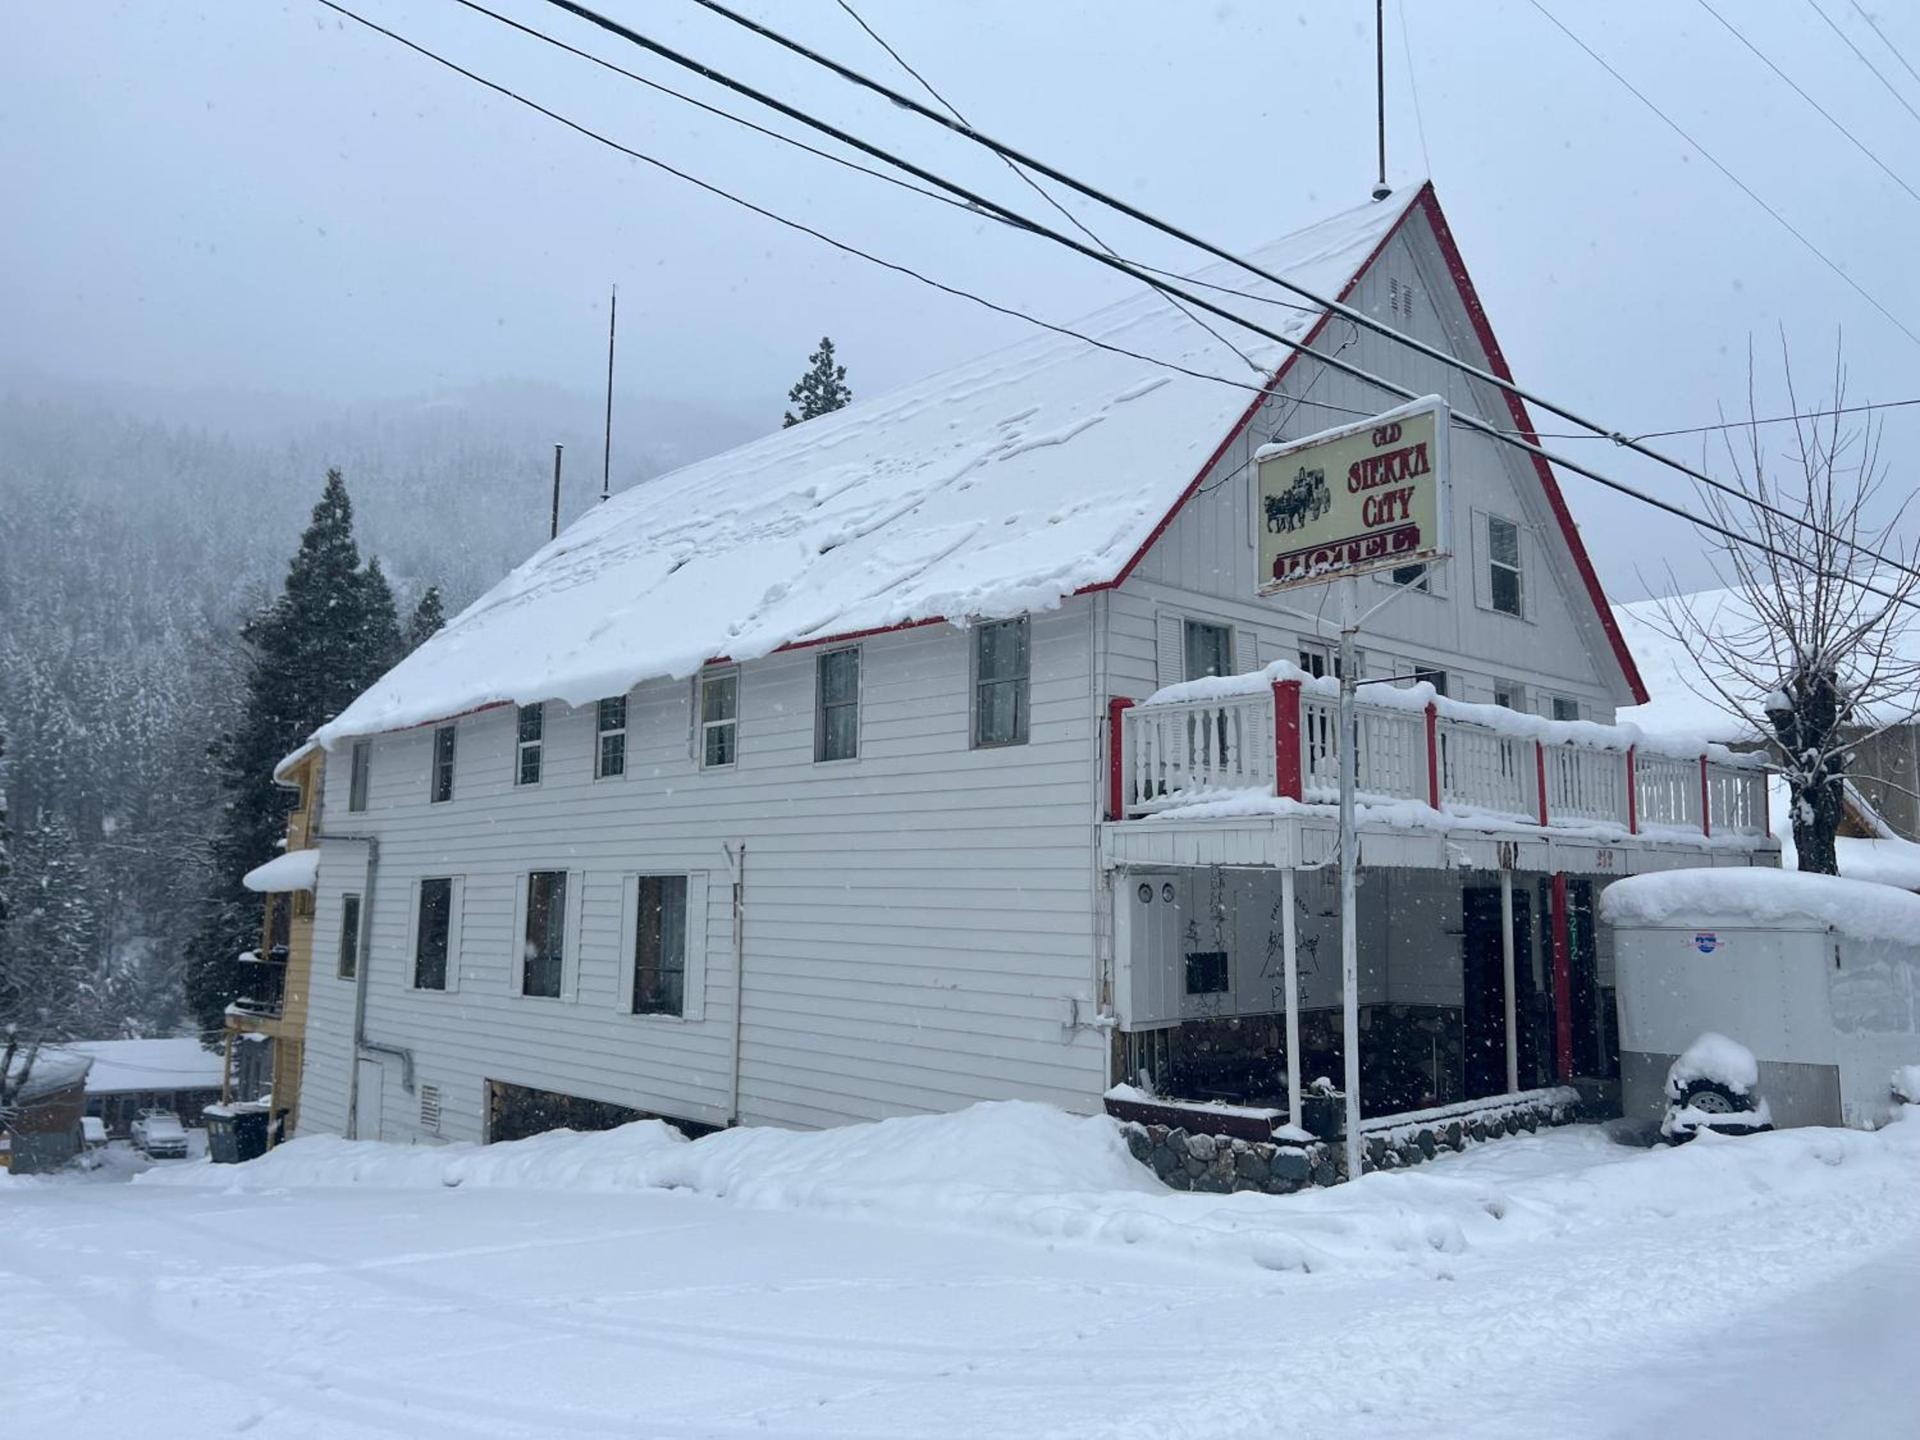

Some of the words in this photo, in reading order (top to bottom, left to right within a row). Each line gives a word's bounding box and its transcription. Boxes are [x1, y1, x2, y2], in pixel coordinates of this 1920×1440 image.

[1372, 422, 1402, 448] OLD
[1347, 442, 1431, 493] SIERRA
[1362, 486, 1415, 528] CITY
[1282, 532, 1410, 578] HOTEL
[1569, 917, 1578, 960] 212
